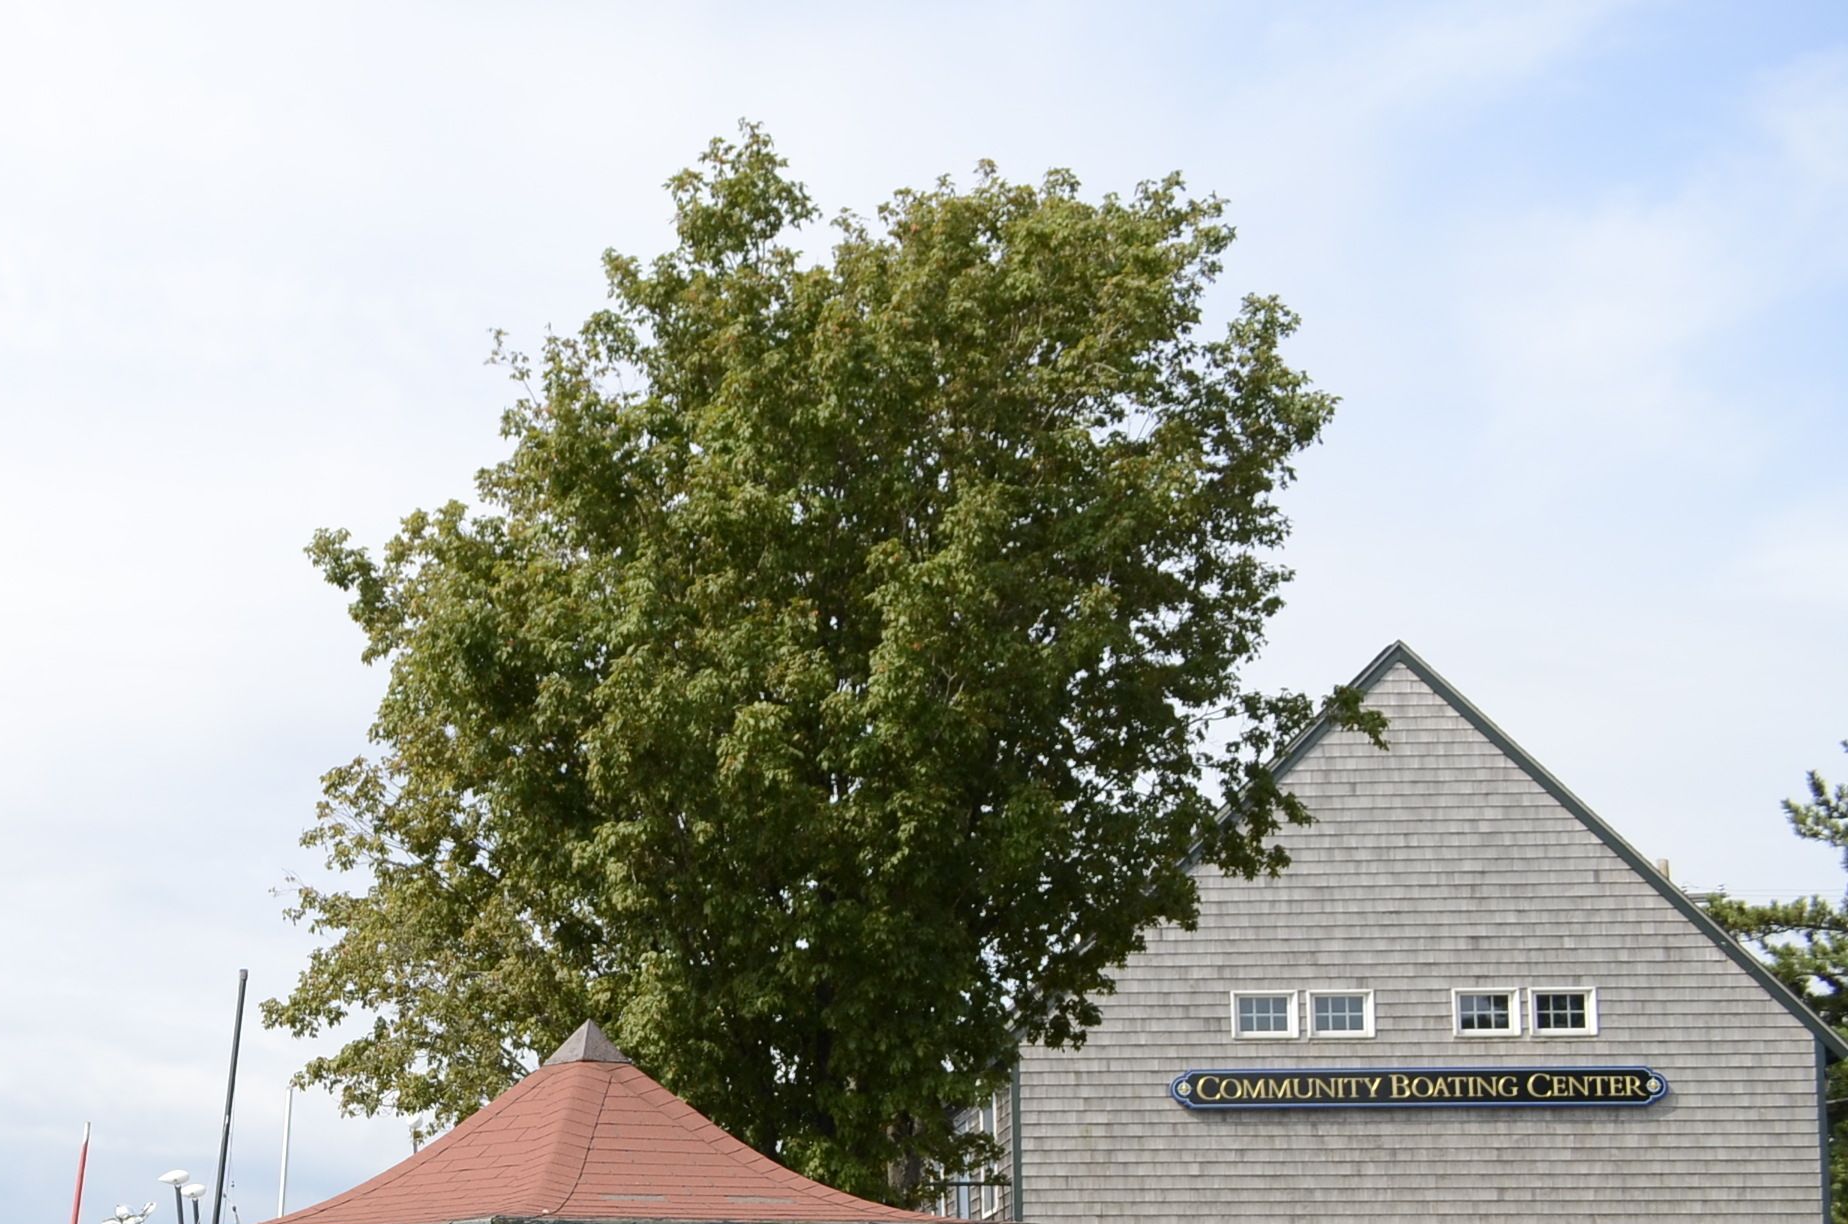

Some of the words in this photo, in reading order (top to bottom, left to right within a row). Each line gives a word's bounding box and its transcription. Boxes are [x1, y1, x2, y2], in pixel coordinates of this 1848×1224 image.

[1196, 1076, 1382, 1100] COMMUNITY
[1388, 1074, 1519, 1098] BOATING
[1527, 1073, 1646, 1097] CENTER
